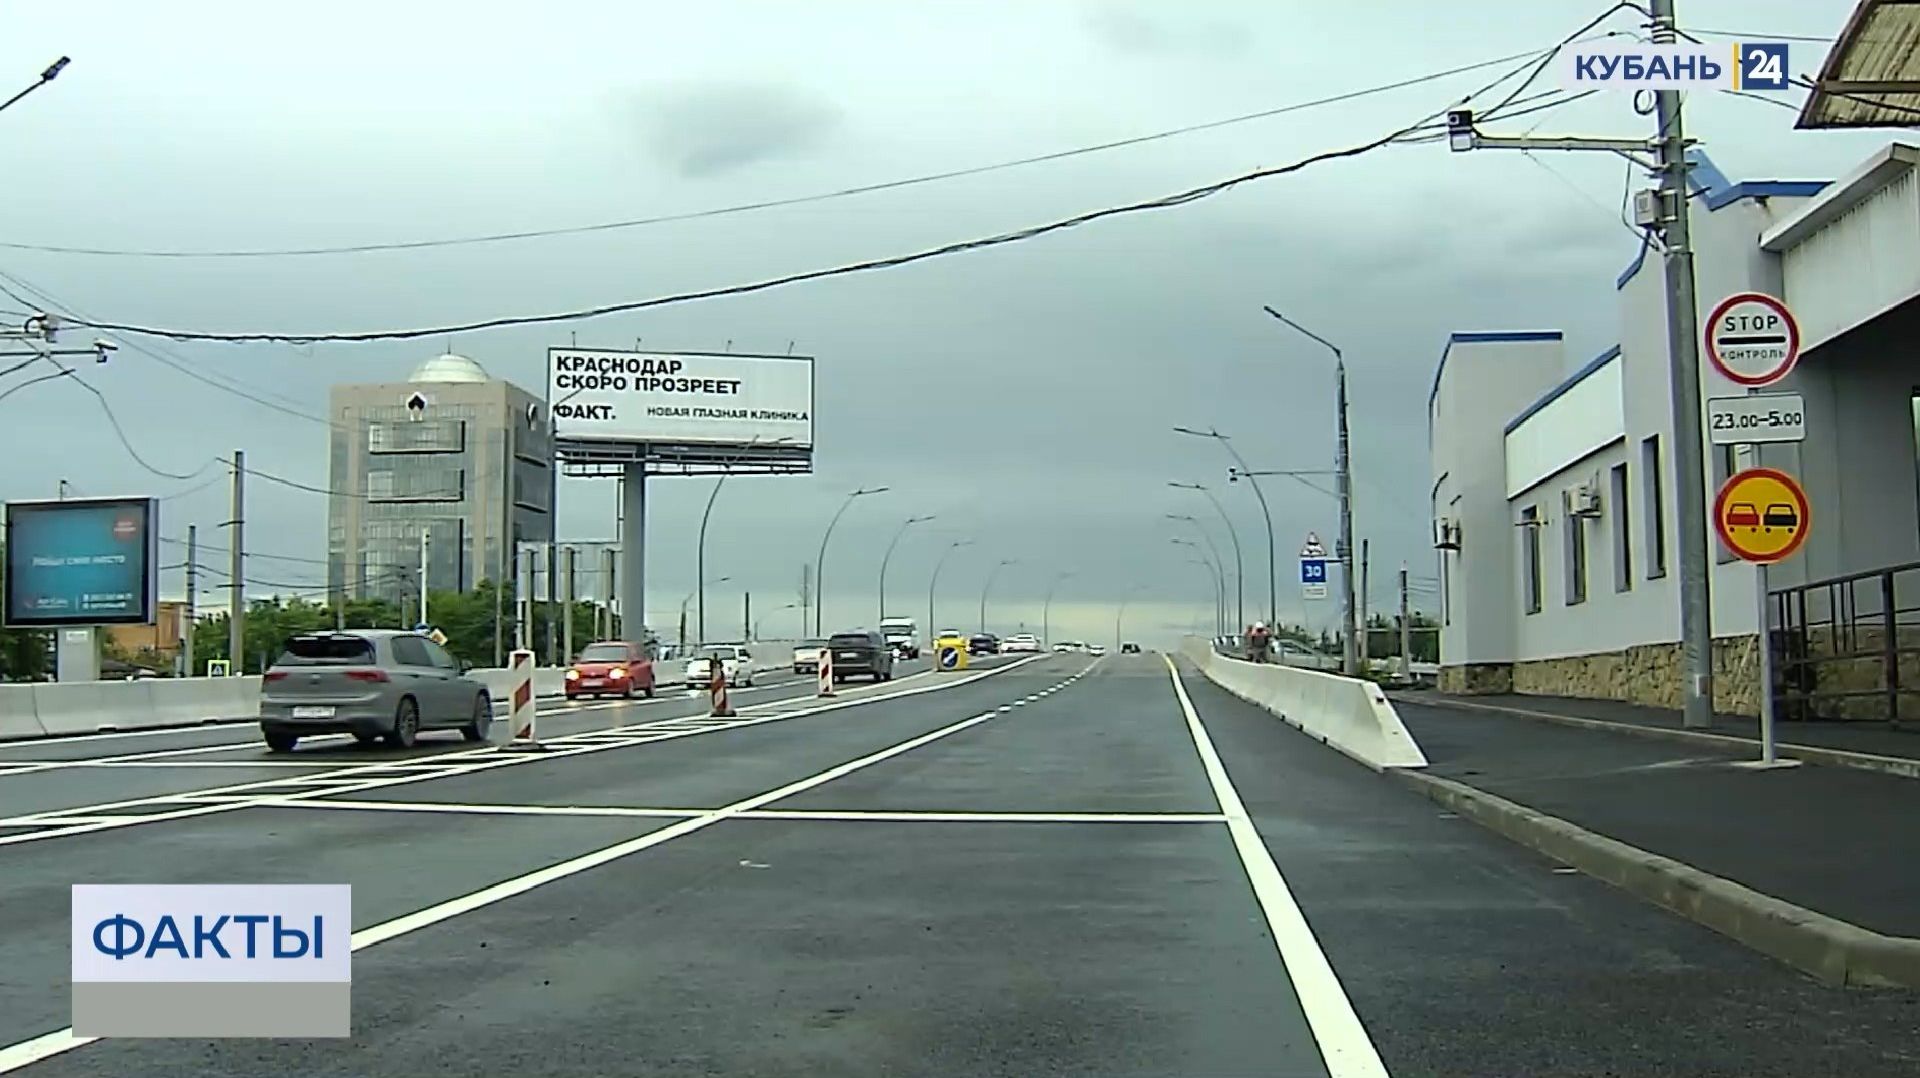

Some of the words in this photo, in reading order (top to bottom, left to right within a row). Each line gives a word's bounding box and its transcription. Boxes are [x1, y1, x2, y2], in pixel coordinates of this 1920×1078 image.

[1725, 316, 1778, 331] STOP
[557, 356, 682, 376] КРАСНОДАР
[557, 374, 626, 390] СКОРО
[635, 377, 741, 394] ПРОЗРЕЕТ
[555, 404, 616, 419] ФАКТ.
[647, 407, 690, 417] НОВАЯ
[693, 408, 748, 419] ГЛАЗНАЯ
[750, 411, 808, 421] КЛИНИКА
[1305, 565, 1322, 577] 30
